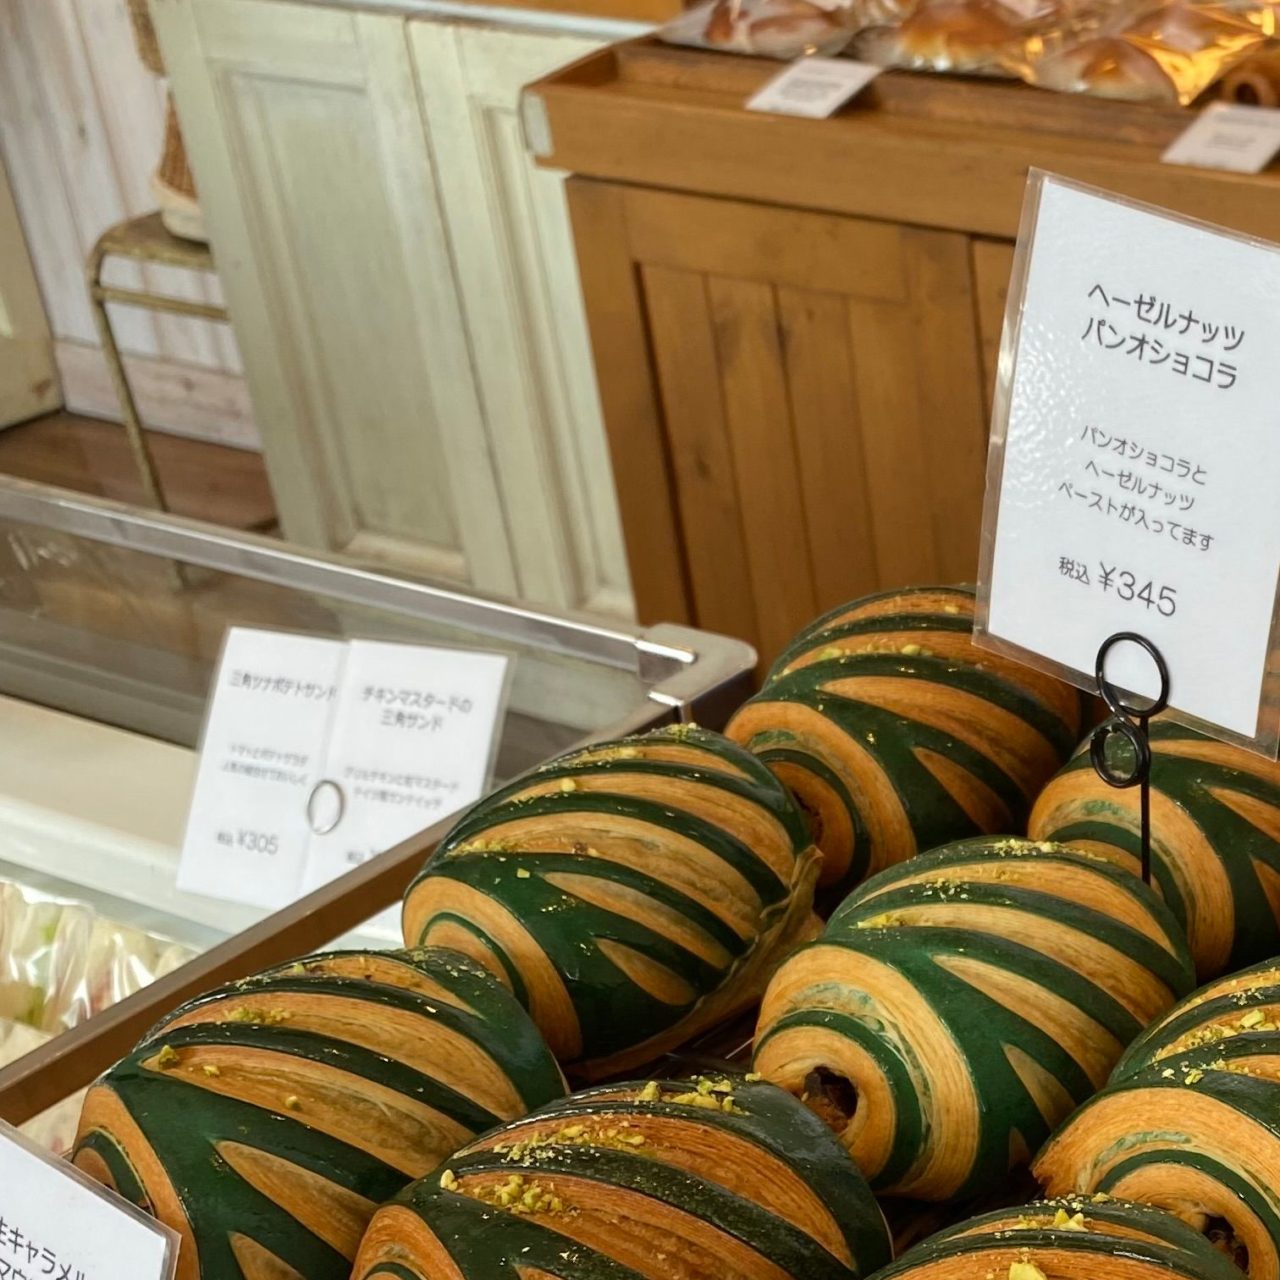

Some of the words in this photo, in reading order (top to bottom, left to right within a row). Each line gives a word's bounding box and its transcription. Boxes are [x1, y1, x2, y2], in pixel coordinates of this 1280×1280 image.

[1088, 284, 1245, 351] ヘーゼルナッツ
[1081, 317, 1237, 389] パンオショコラ
[1081, 425, 1207, 485] パンオショコラと
[1085, 461, 1195, 510] ヘーゼルナッツ
[1058, 482, 1214, 551] ペーストが入ってます
[1059, 556, 1091, 586] 税込
[1098, 561, 1177, 617] ¥345
